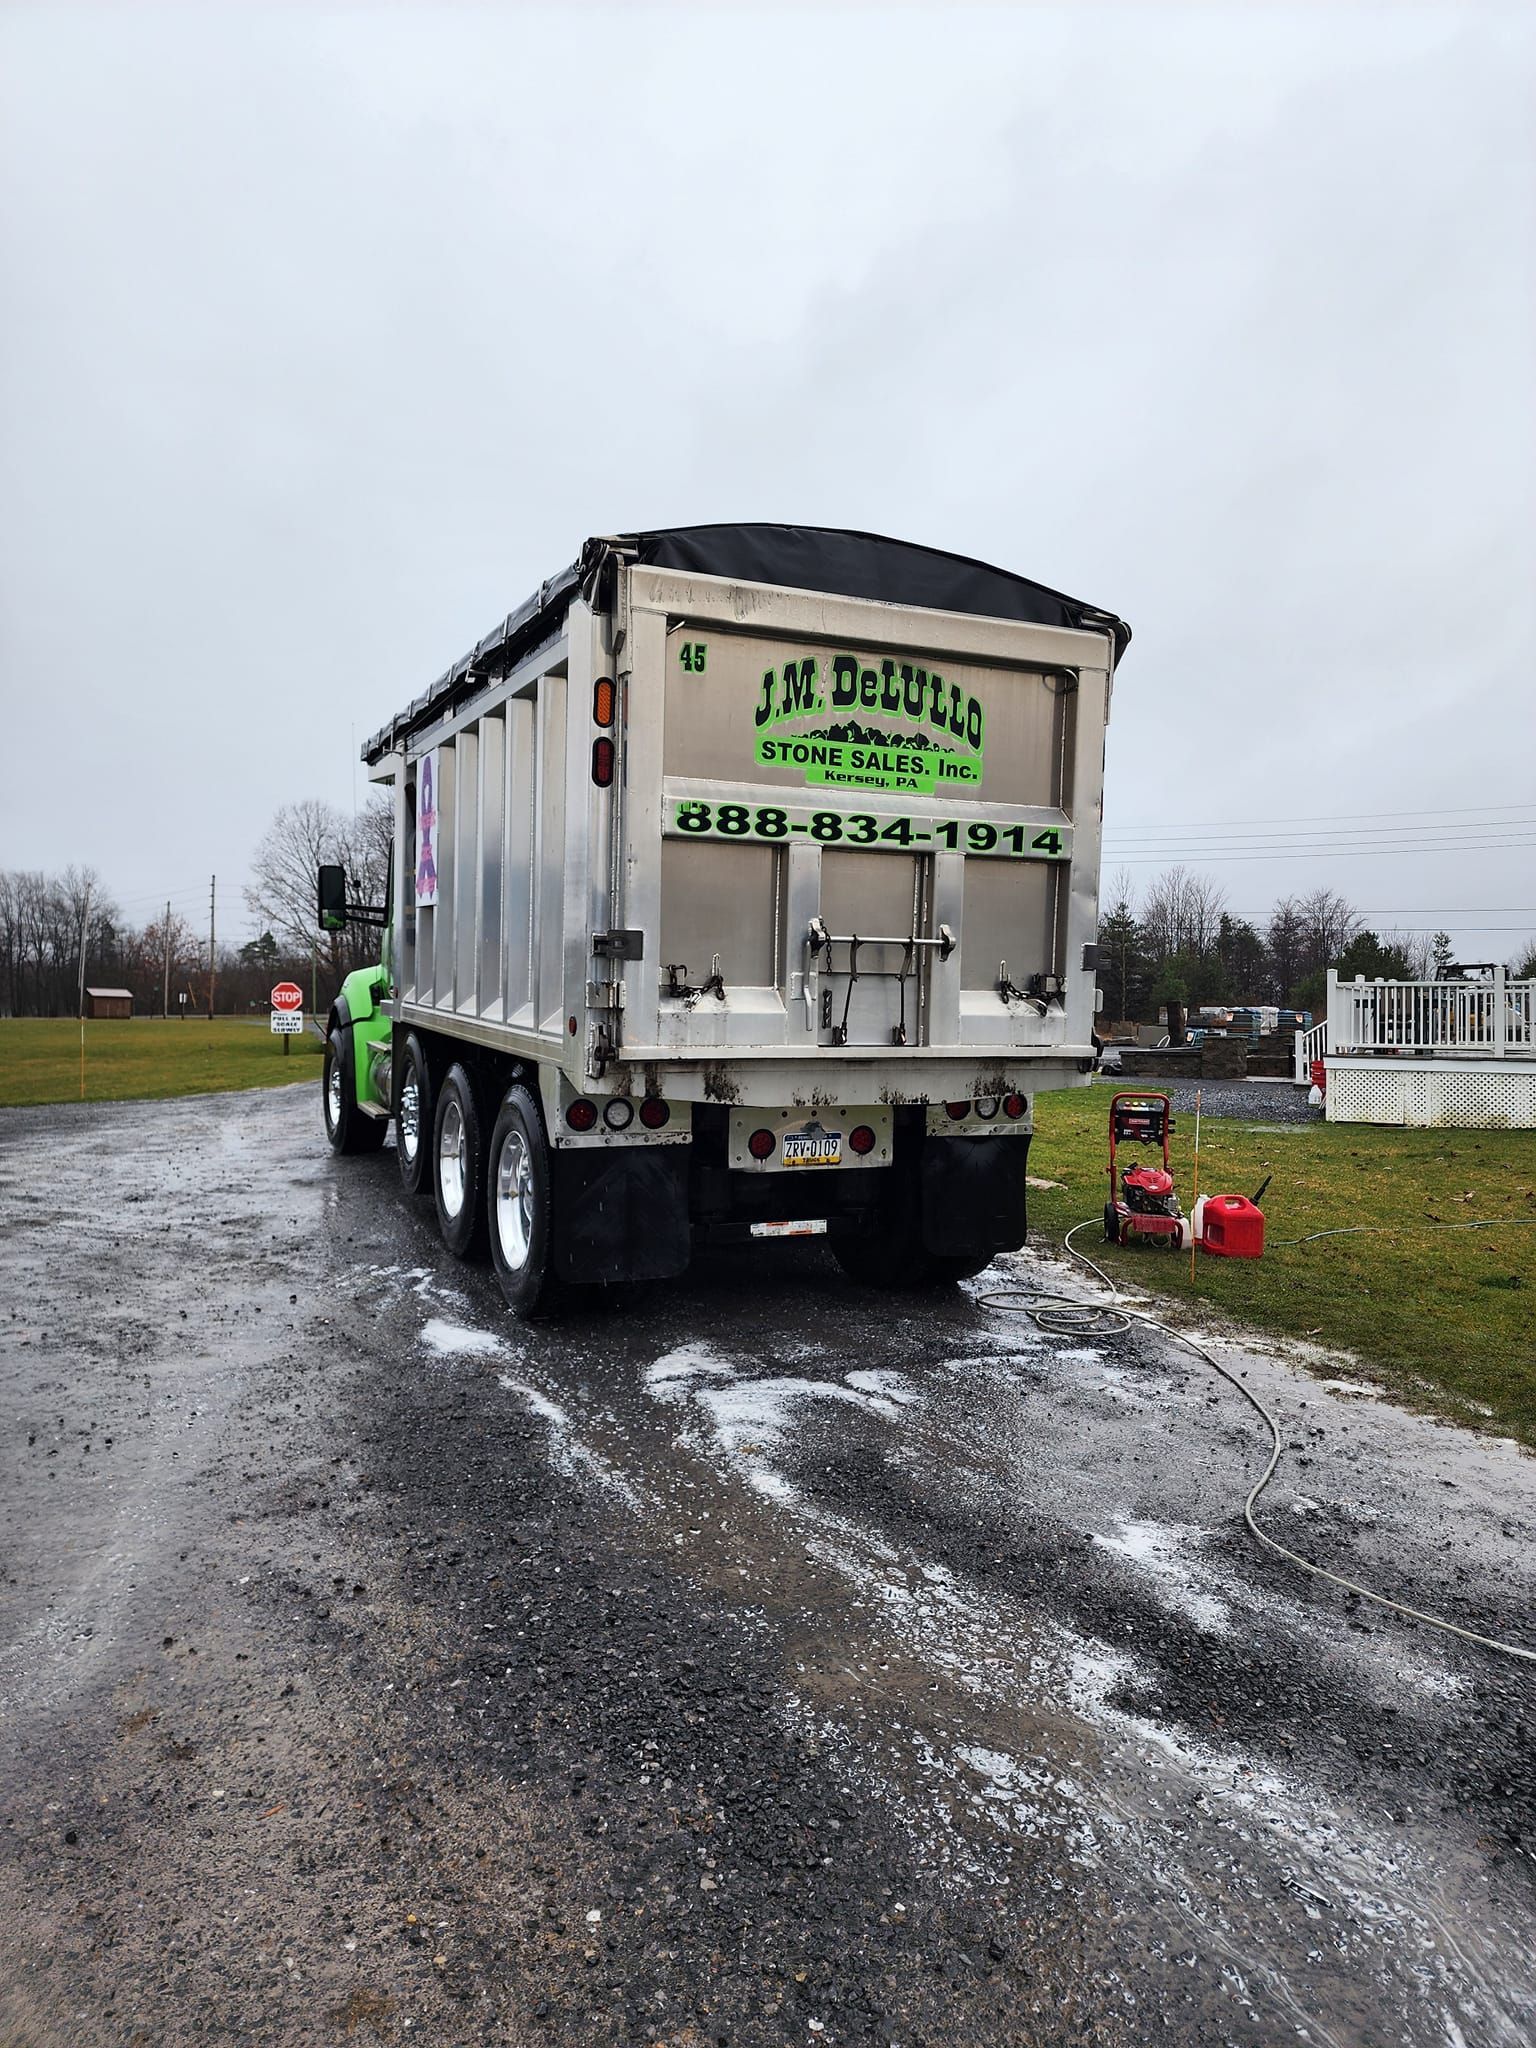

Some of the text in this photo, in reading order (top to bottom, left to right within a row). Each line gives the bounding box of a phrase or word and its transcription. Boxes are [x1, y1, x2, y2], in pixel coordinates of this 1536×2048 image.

[680, 643, 706, 673] 45
[755, 656, 983, 750] J.M. DeLULLO
[761, 740, 843, 767] STONE
[938, 758, 978, 780] Inc.
[824, 770, 918, 788] Kersey, PA
[676, 802, 1063, 855] 888-834-1914
[273, 991, 301, 1003] STOP
